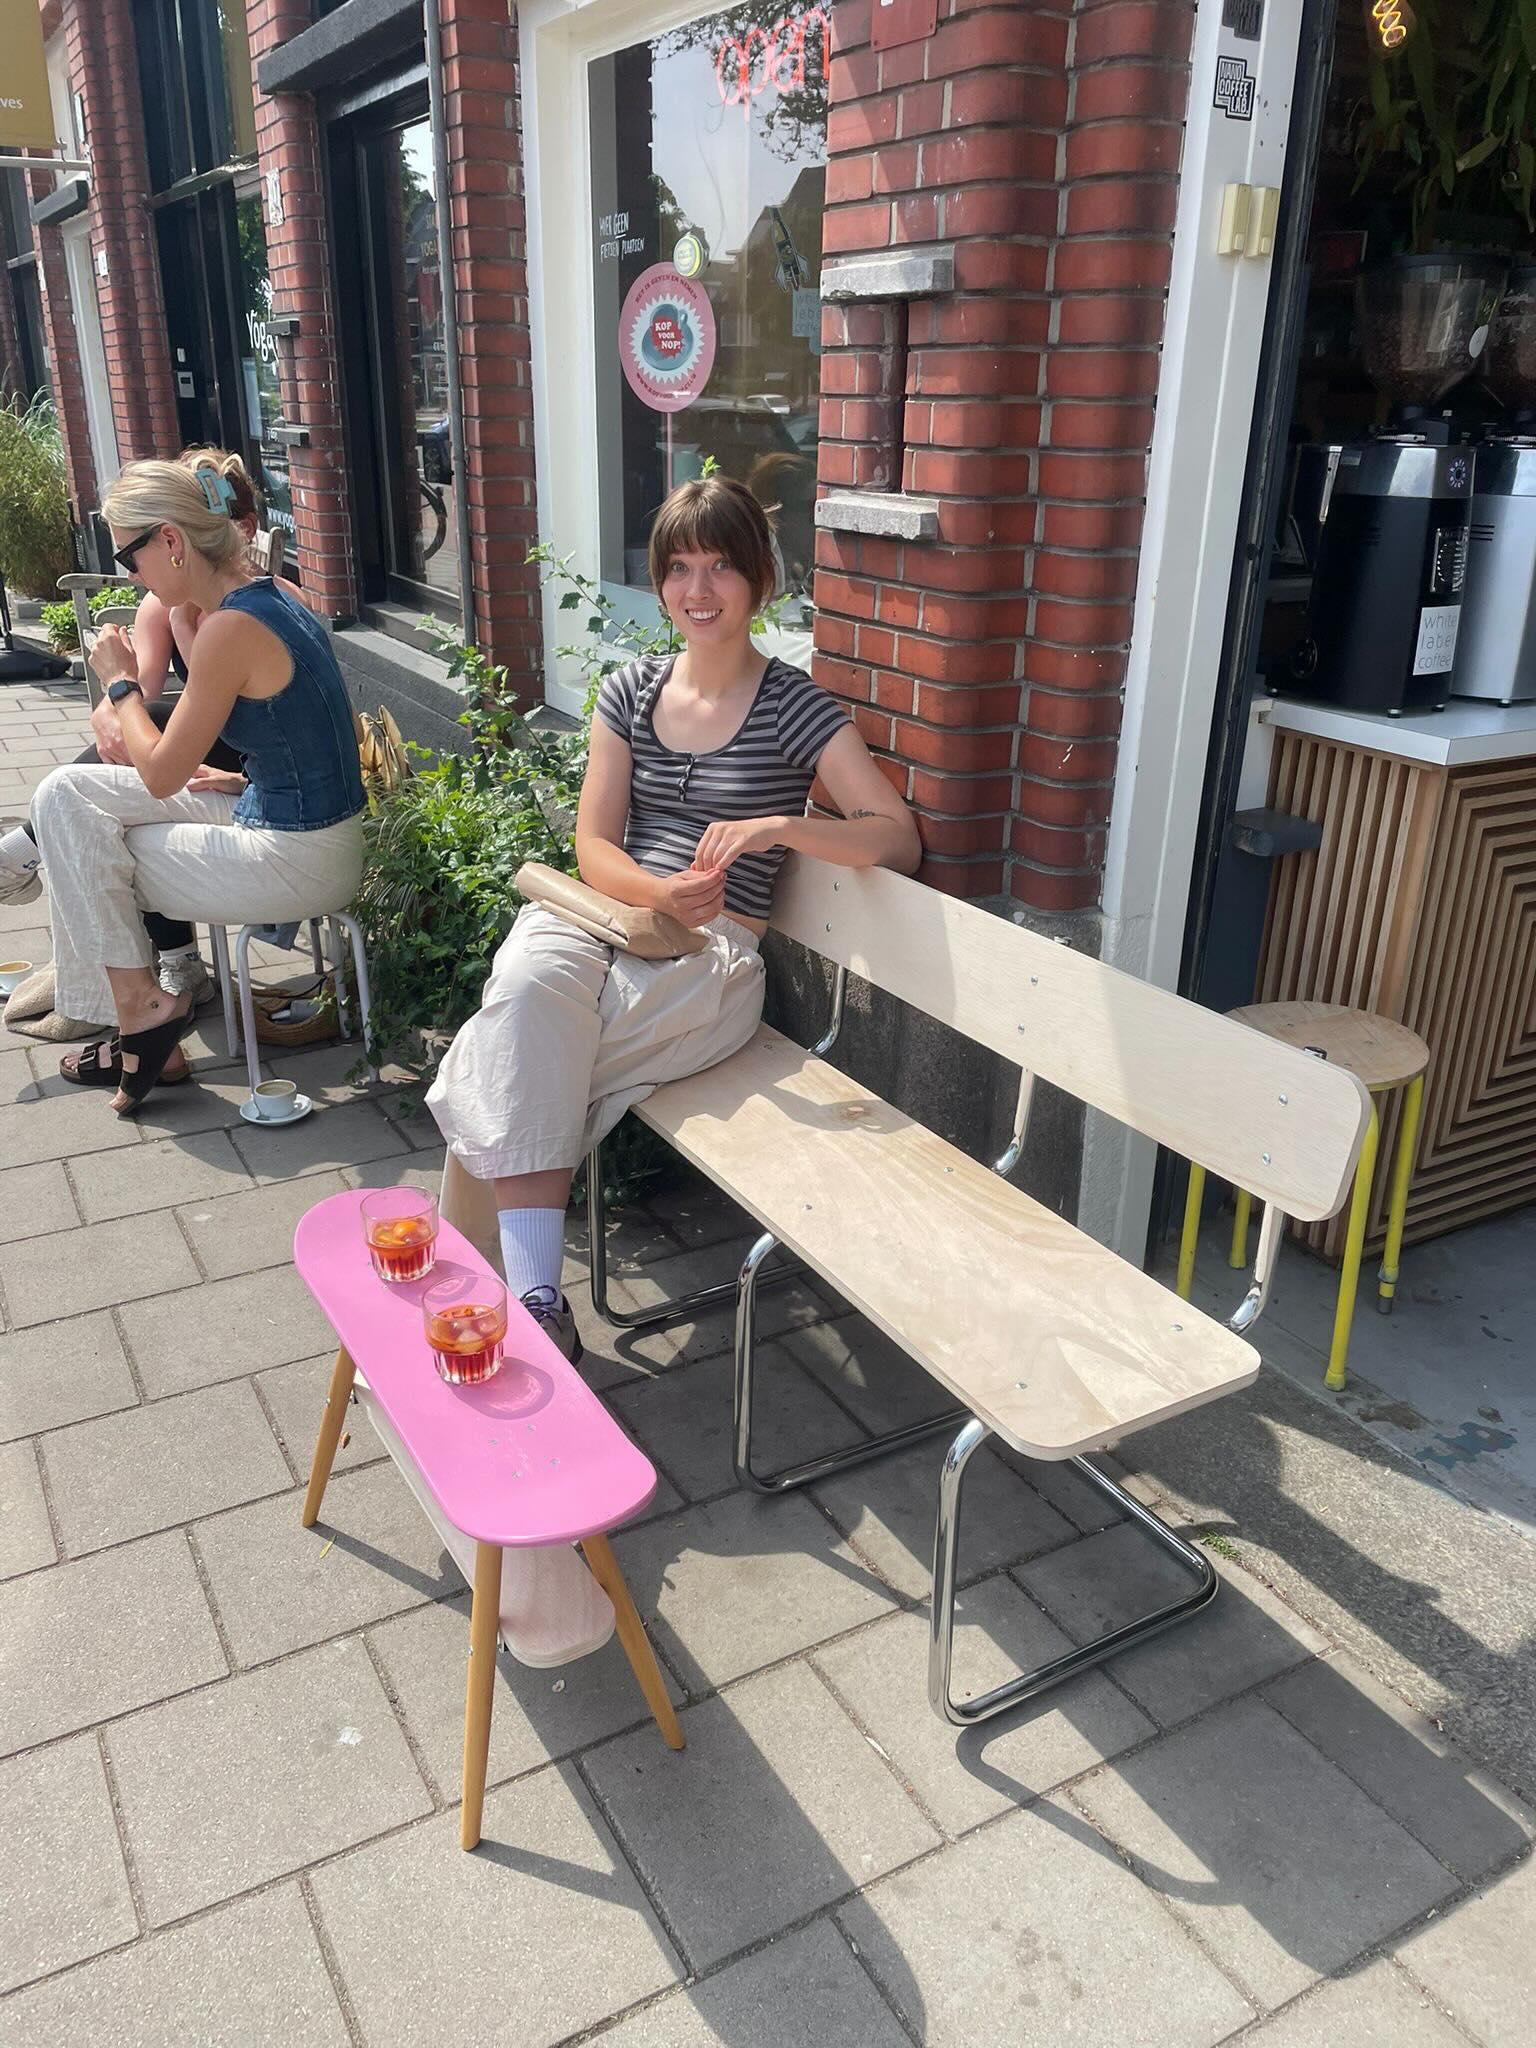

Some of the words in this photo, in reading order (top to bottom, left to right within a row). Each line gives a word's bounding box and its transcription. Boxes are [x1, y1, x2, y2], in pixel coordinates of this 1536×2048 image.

[1220, 62, 1243, 80] NANO
[1218, 79, 1249, 98] COFFEE
[0, 97, 24, 110] ves
[613, 211, 629, 236] GEEN
[655, 321, 672, 332] KOP
[658, 331, 676, 340] VOOR
[661, 340, 681, 350] NOP!
[1424, 614, 1457, 629] white
[1420, 633, 1455, 649] label
[1418, 654, 1451, 669] coffee
